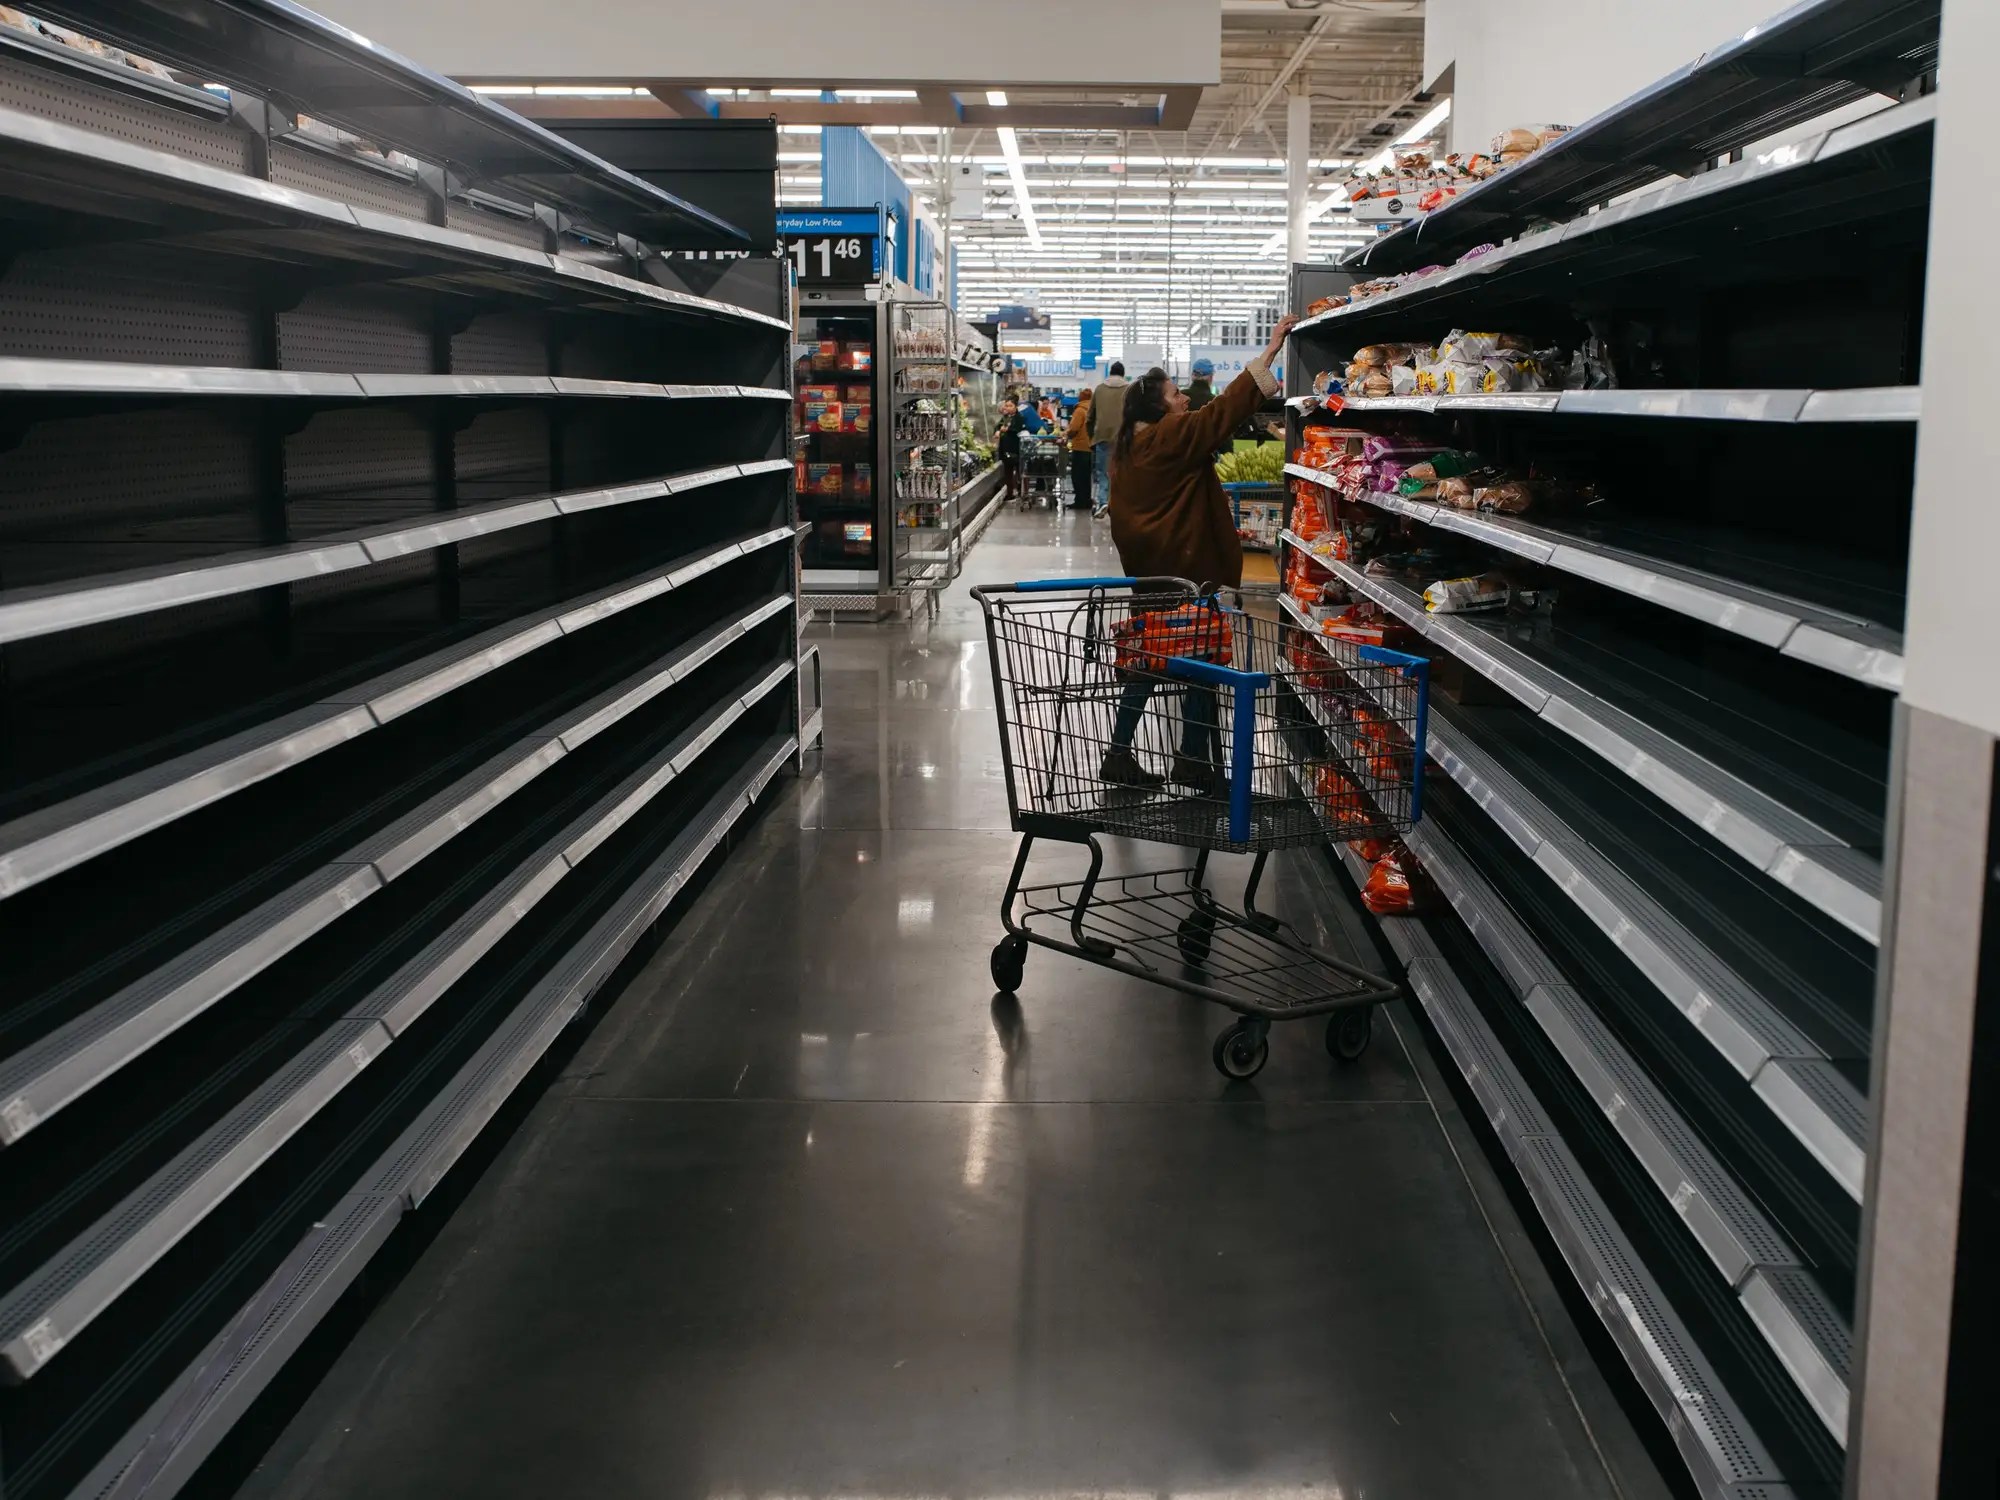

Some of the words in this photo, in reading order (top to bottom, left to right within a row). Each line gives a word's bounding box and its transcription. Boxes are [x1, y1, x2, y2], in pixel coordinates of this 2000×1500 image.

[775, 218, 804, 229] eryday
[805, 218, 821, 227] Low
[822, 218, 843, 227] Price
[1029, 360, 1074, 375] UTDOOR
[1212, 360, 1230, 371] rab
